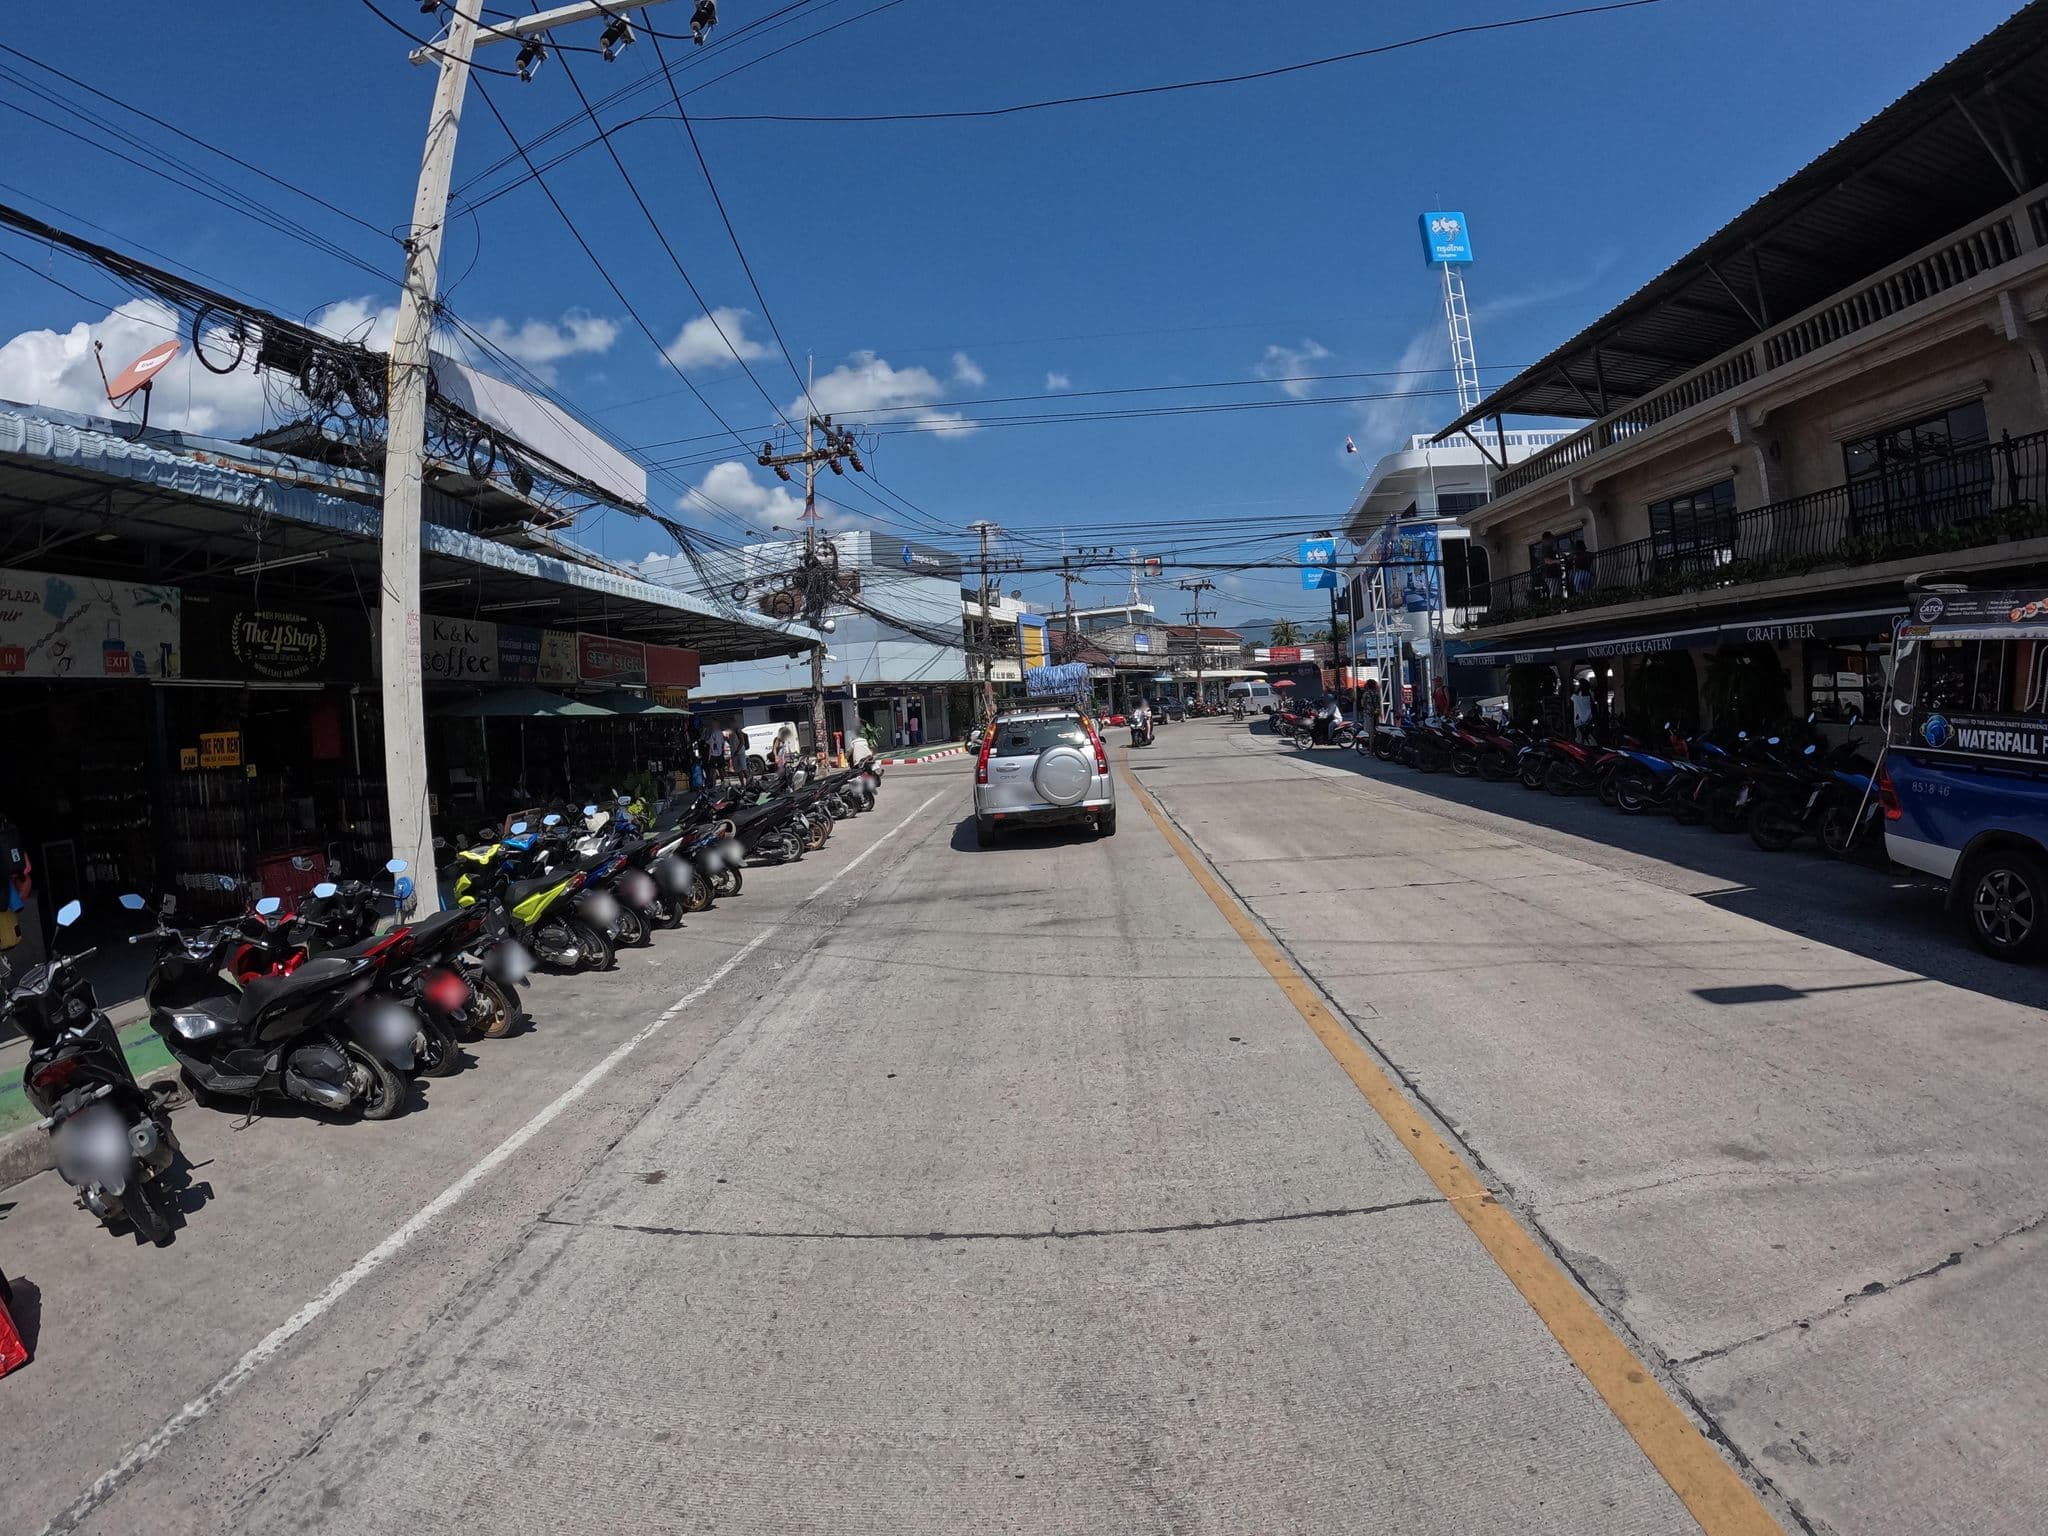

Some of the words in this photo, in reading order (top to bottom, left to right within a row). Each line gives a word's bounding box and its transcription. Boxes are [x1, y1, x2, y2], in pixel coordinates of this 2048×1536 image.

[0, 590, 41, 603] PLAZA
[1919, 605, 1944, 613] CATCH
[242, 622, 269, 644] The
[283, 625, 319, 652] Shop
[1746, 626, 1783, 641] CRAFT
[1786, 624, 1816, 639] BEER
[1587, 645, 1614, 657] INDIGO
[106, 656, 128, 667] EXIT
[1957, 728, 2039, 755] WATERFALL
